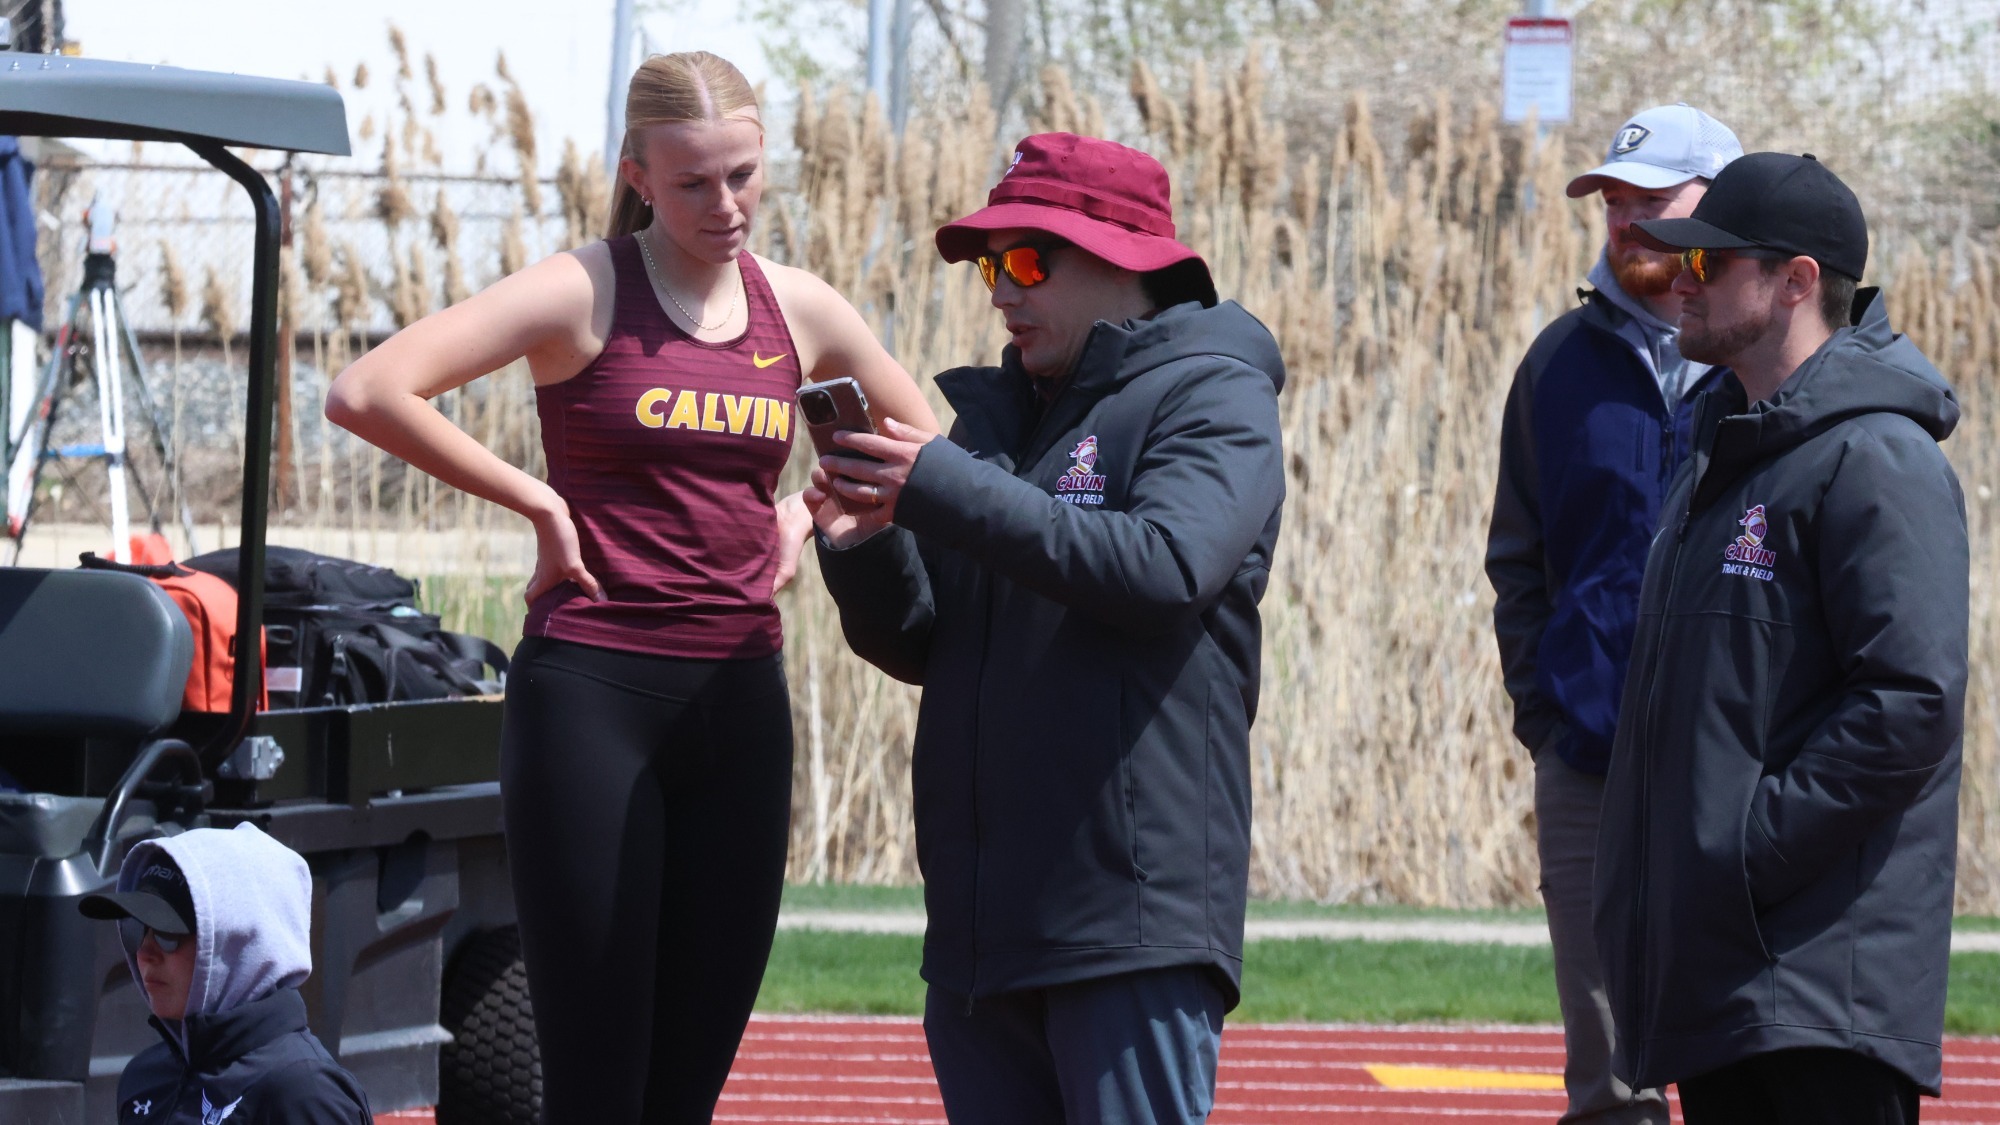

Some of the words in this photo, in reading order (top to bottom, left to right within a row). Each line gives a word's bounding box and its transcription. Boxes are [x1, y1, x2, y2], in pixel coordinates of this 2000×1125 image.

[1617, 128, 1641, 149] T
[636, 388, 790, 441] CALVIN
[1056, 475, 1106, 491] CALVIN
[1075, 494, 1081, 504] &
[1082, 494, 1104, 504] FIELD
[1725, 544, 1776, 567] CALVIN
[1722, 563, 1743, 575] TRACK
[1743, 566, 1749, 577] &
[1750, 567, 1774, 581] FIELD
